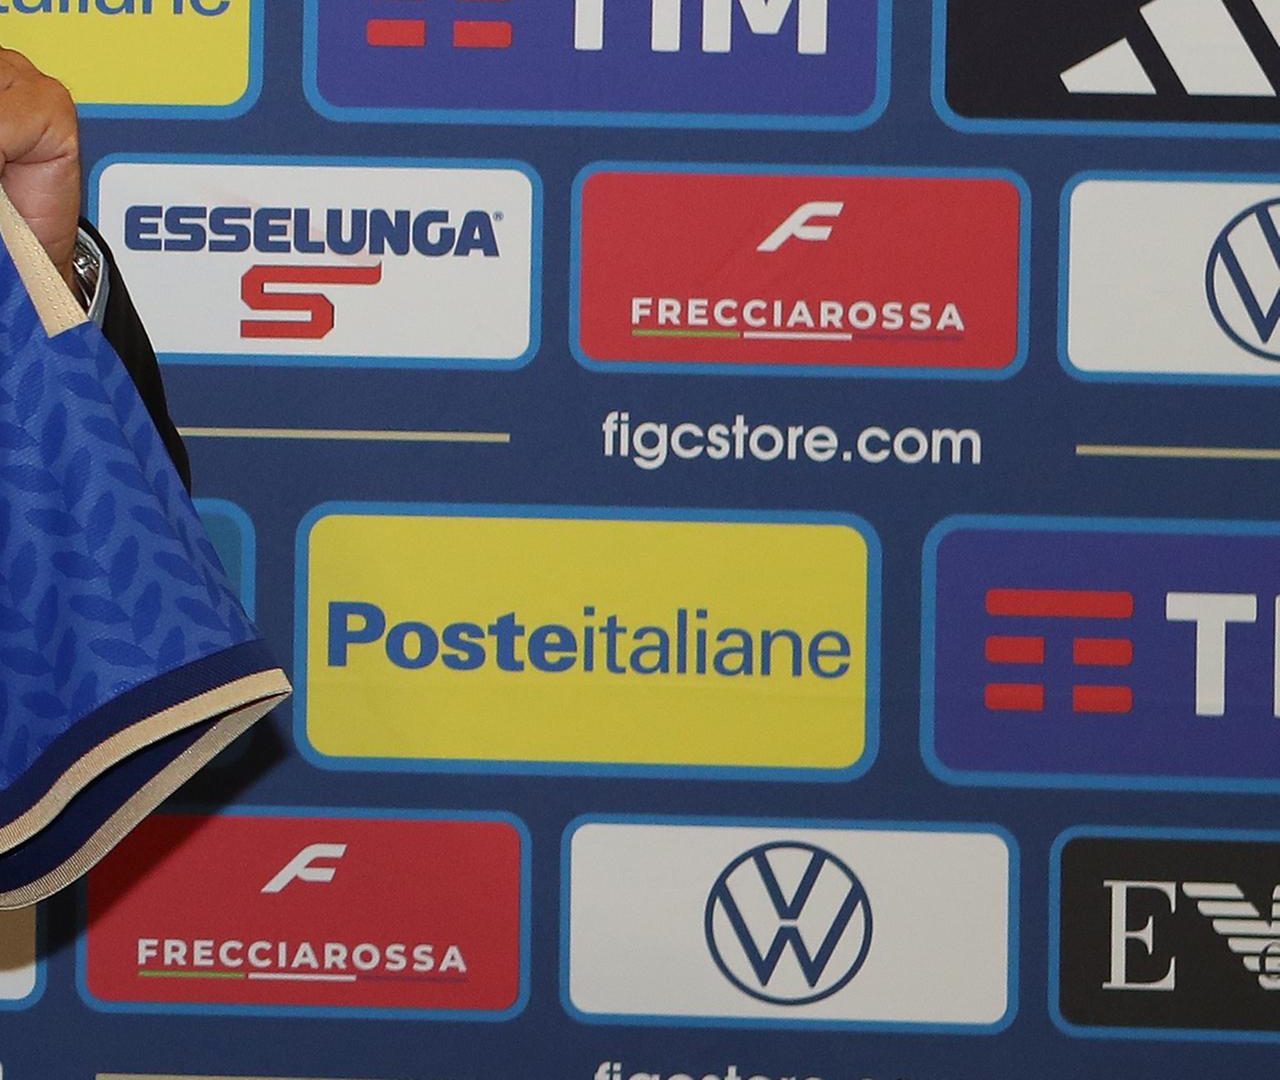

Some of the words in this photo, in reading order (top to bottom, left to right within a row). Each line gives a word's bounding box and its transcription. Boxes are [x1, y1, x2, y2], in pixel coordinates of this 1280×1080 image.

[633, 299, 965, 331] FRECCIAROSSA
[604, 413, 981, 470] figcstore.com
[329, 602, 852, 680] Posteitaliane
[137, 938, 468, 973] FRECCIAROSSA
